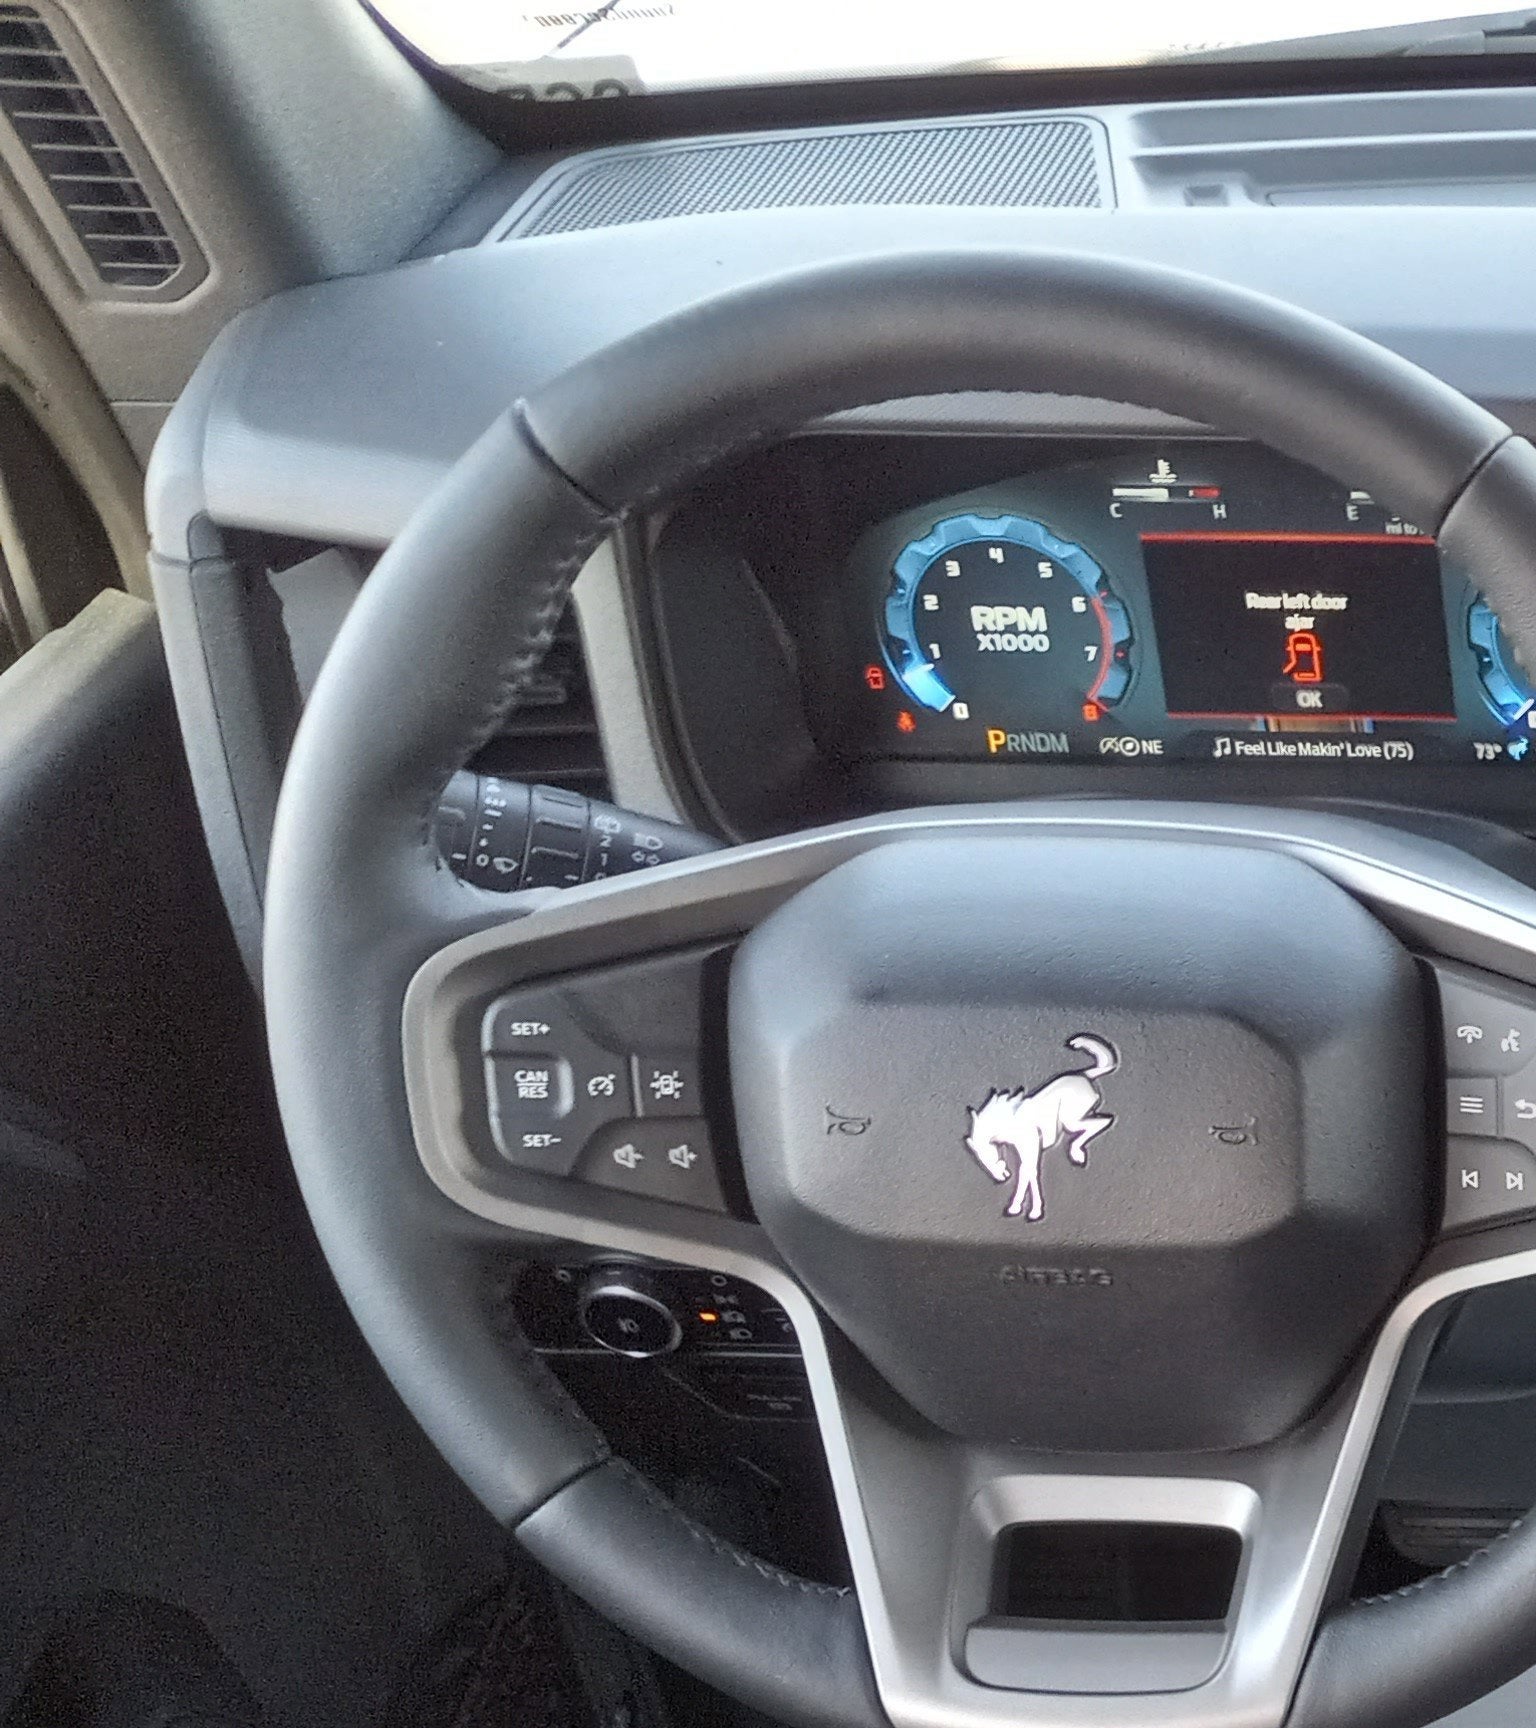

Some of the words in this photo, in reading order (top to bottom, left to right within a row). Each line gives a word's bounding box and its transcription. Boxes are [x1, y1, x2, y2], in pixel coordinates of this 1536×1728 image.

[1109, 503, 1122, 518] C
[1213, 505, 1226, 519] H
[1347, 506, 1360, 520] E
[988, 547, 1005, 563] 4
[945, 560, 961, 577] 3
[1037, 562, 1053, 578] 5
[923, 595, 939, 610] 2
[1071, 596, 1086, 613] 6
[1246, 593, 1281, 609] Rear
[1283, 593, 1310, 609] left
[1311, 594, 1348, 610] door
[970, 605, 1048, 632] RPM
[1285, 615, 1314, 631] ajar
[977, 633, 1051, 652] X1000
[929, 643, 940, 659] 1
[1084, 645, 1098, 662] 7
[1296, 690, 1322, 708] OK
[952, 702, 969, 720] 0
[1082, 703, 1100, 722] 8
[1141, 741, 1163, 754] NE
[1235, 741, 1264, 755] Feel
[1268, 742, 1296, 756] Like
[1298, 742, 1344, 757] Makin'
[1347, 744, 1381, 758] Love
[1384, 743, 1413, 760] (75)
[511, 1022, 550, 1036] SET+
[514, 1070, 549, 1082] CAN
[518, 1086, 549, 1099] RES
